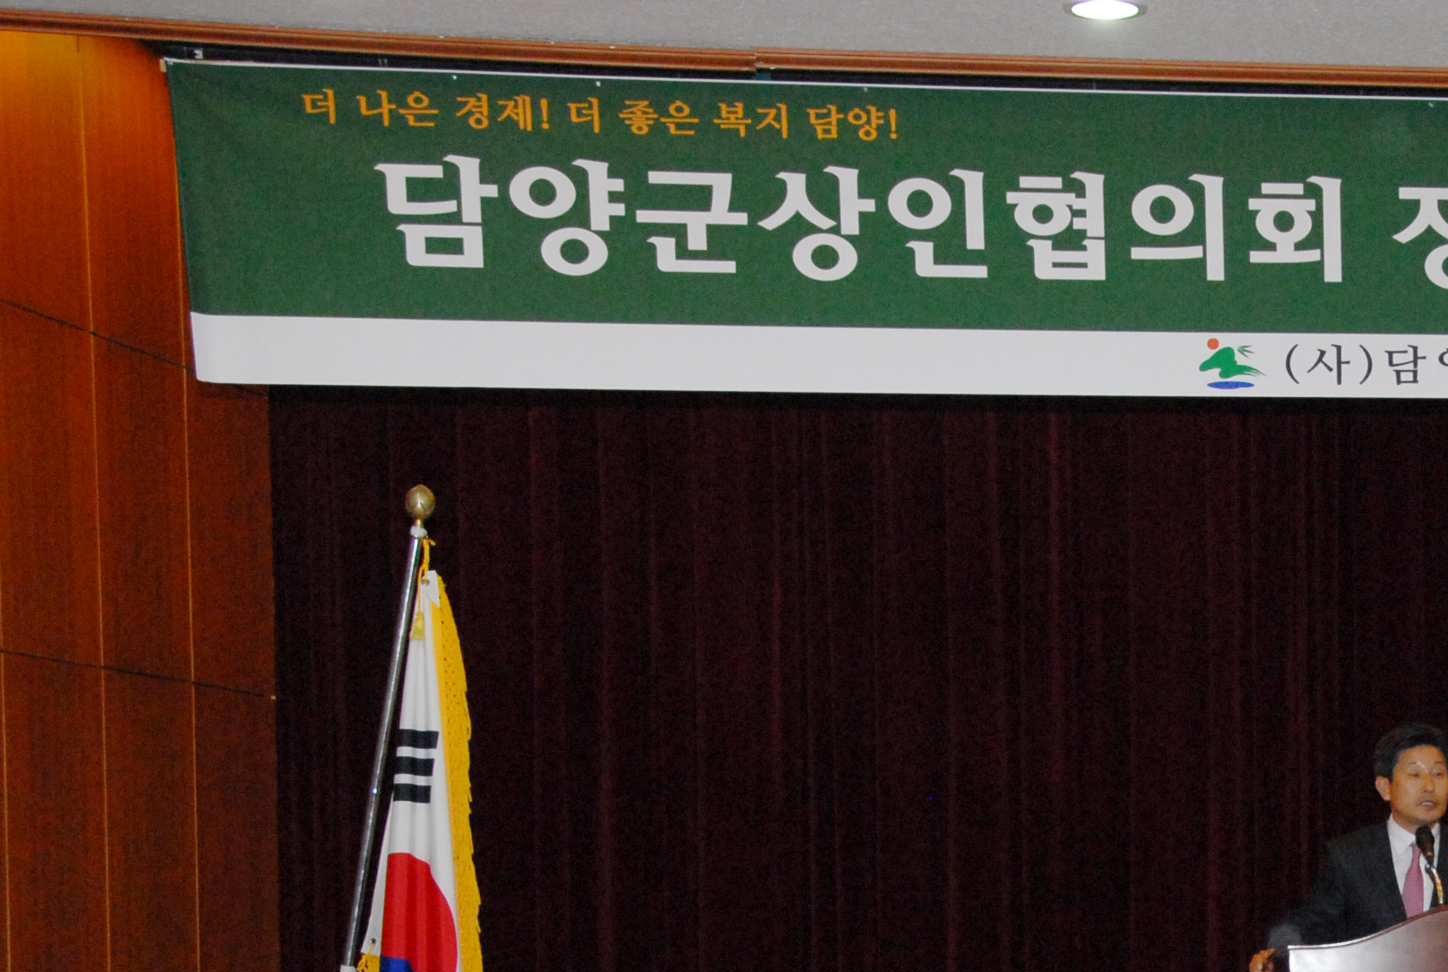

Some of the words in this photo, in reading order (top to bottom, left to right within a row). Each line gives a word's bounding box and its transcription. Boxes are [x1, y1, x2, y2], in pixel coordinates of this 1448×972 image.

[302, 89, 337, 126] 더
[357, 90, 440, 128] 나은
[457, 93, 551, 133] 경제!
[568, 98, 602, 135] 더
[619, 100, 700, 136] 좋은
[713, 101, 790, 140] 복지
[807, 104, 898, 142] 담양!
[374, 155, 1344, 284] 담양군상인협의회
